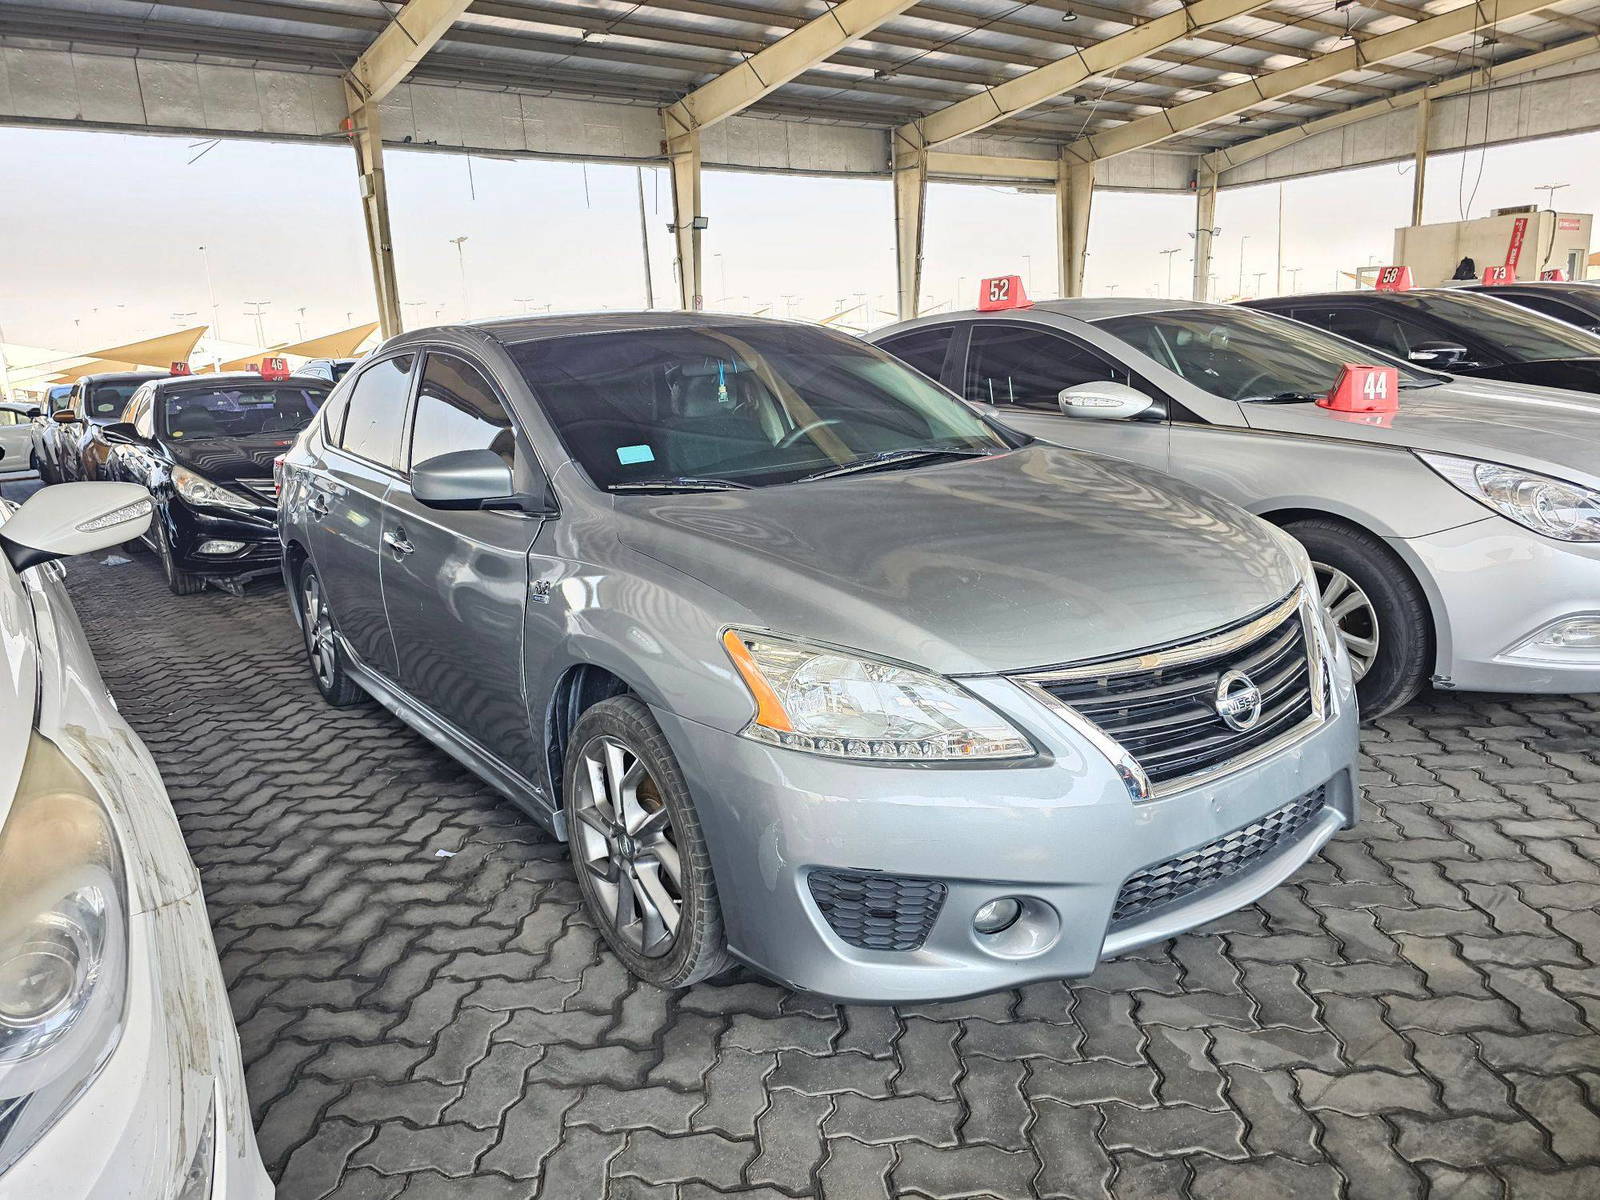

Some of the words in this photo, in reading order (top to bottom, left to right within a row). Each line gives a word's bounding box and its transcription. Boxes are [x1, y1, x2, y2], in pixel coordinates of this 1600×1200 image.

[1382, 267, 1399, 284] 58
[1493, 267, 1506, 280] 73
[990, 279, 1009, 302] 52
[176, 363, 185, 372] 47
[272, 359, 283, 370] 46
[1363, 371, 1388, 400] 44
